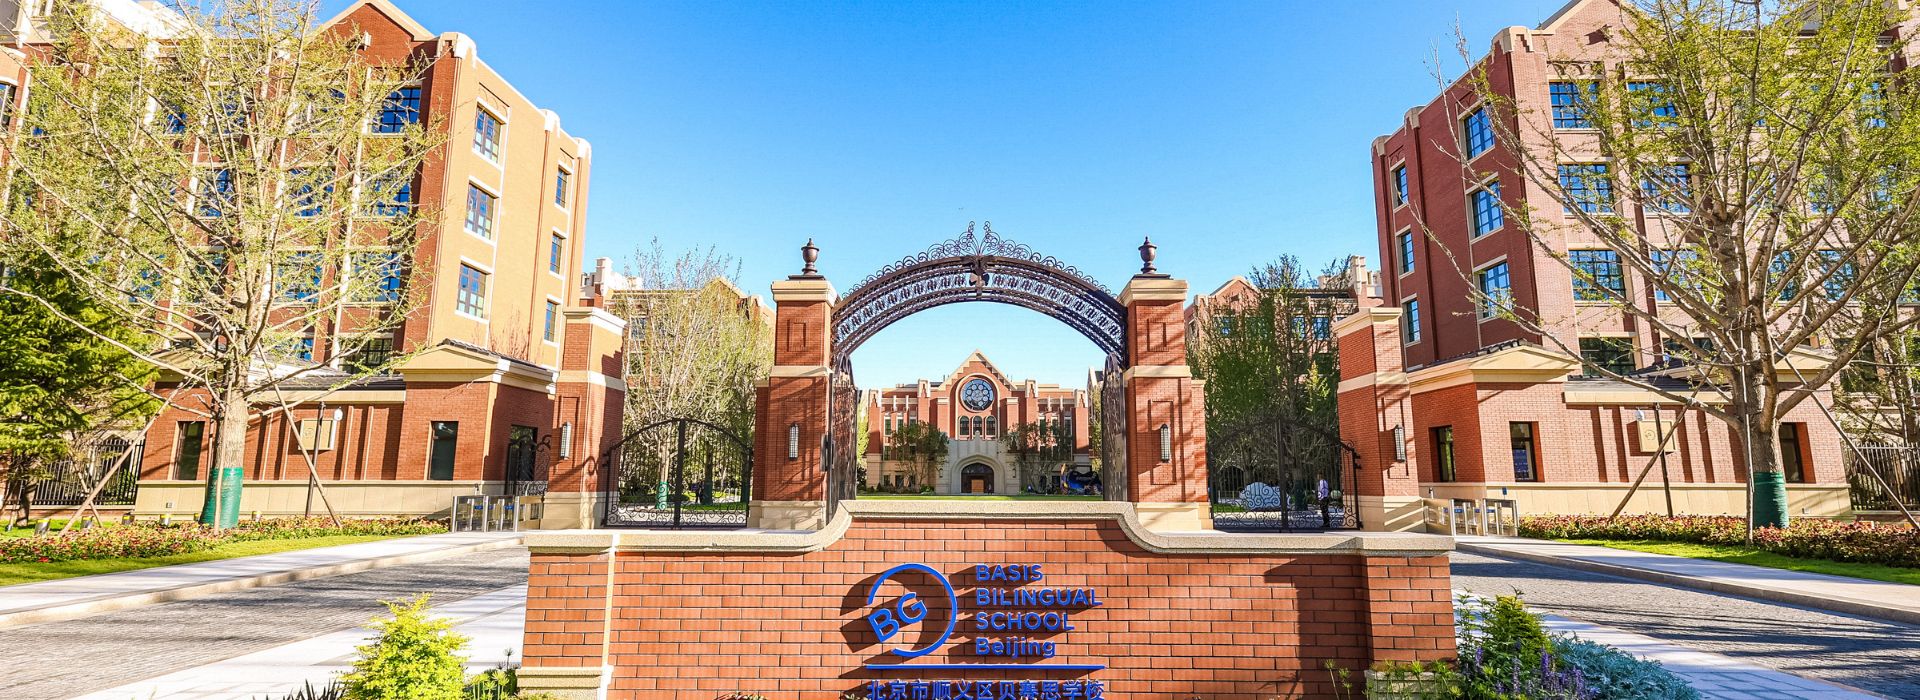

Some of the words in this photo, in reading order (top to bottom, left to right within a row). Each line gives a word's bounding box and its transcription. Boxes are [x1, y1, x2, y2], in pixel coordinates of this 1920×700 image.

[975, 564, 1043, 581] BASIS
[975, 588, 1103, 606] BILINGUAL
[867, 592, 928, 643] BG
[975, 612, 1075, 630] SCHOOL
[975, 637, 1056, 659] Beijing
[866, 679, 1105, 700] 北京市顺义区贝赛思学校
